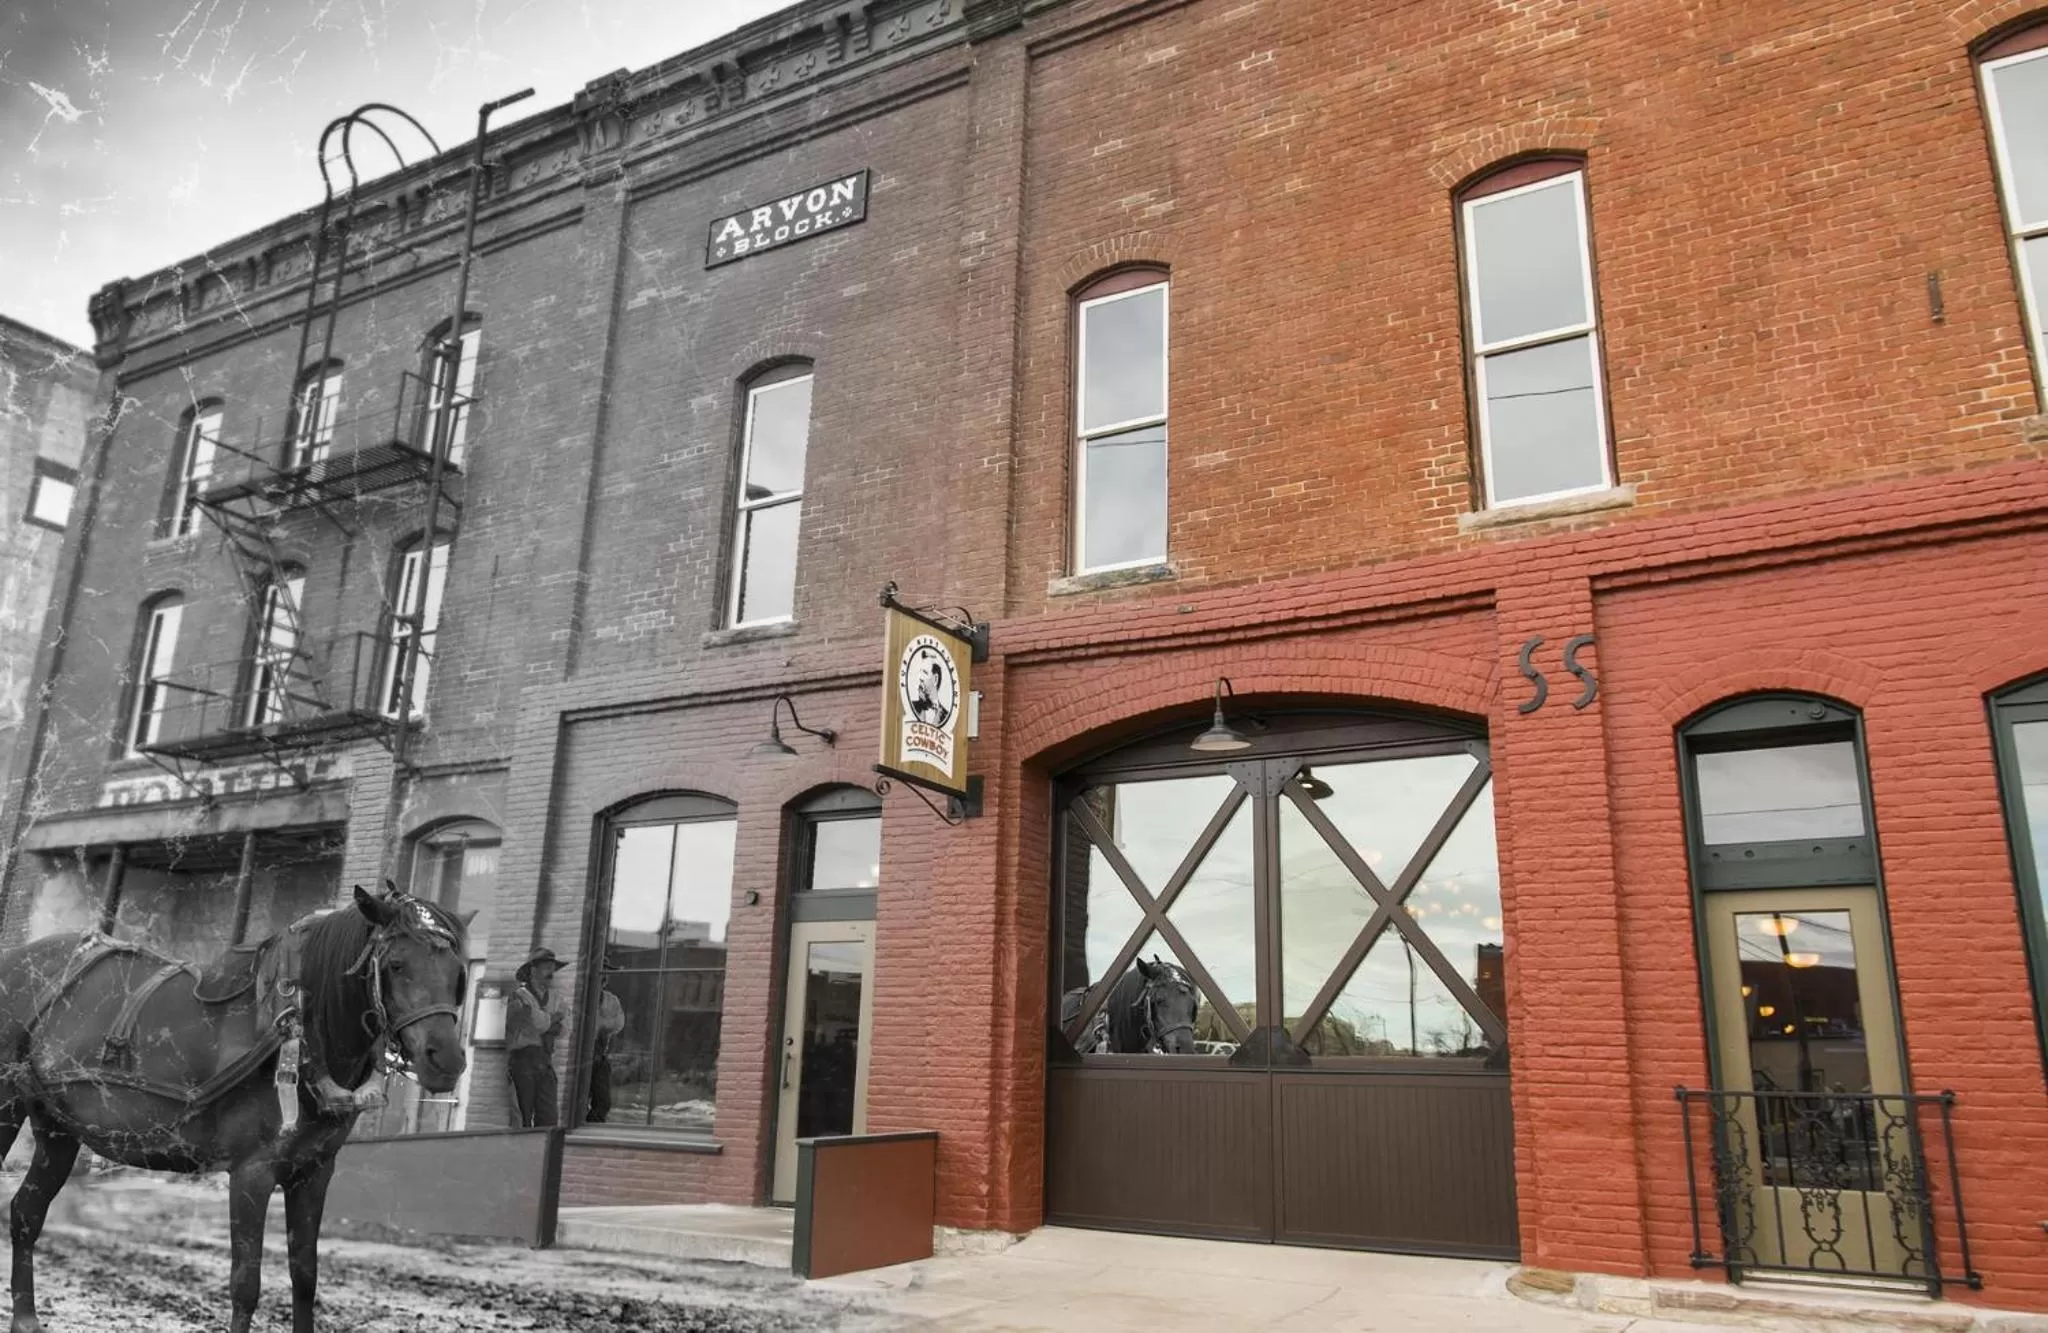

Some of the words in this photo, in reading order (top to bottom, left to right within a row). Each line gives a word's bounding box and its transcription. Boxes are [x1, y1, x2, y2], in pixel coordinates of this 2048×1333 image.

[715, 176, 857, 243] ARVON
[910, 723, 946, 745] CELTIC
[905, 735, 949, 759] COWBOY
